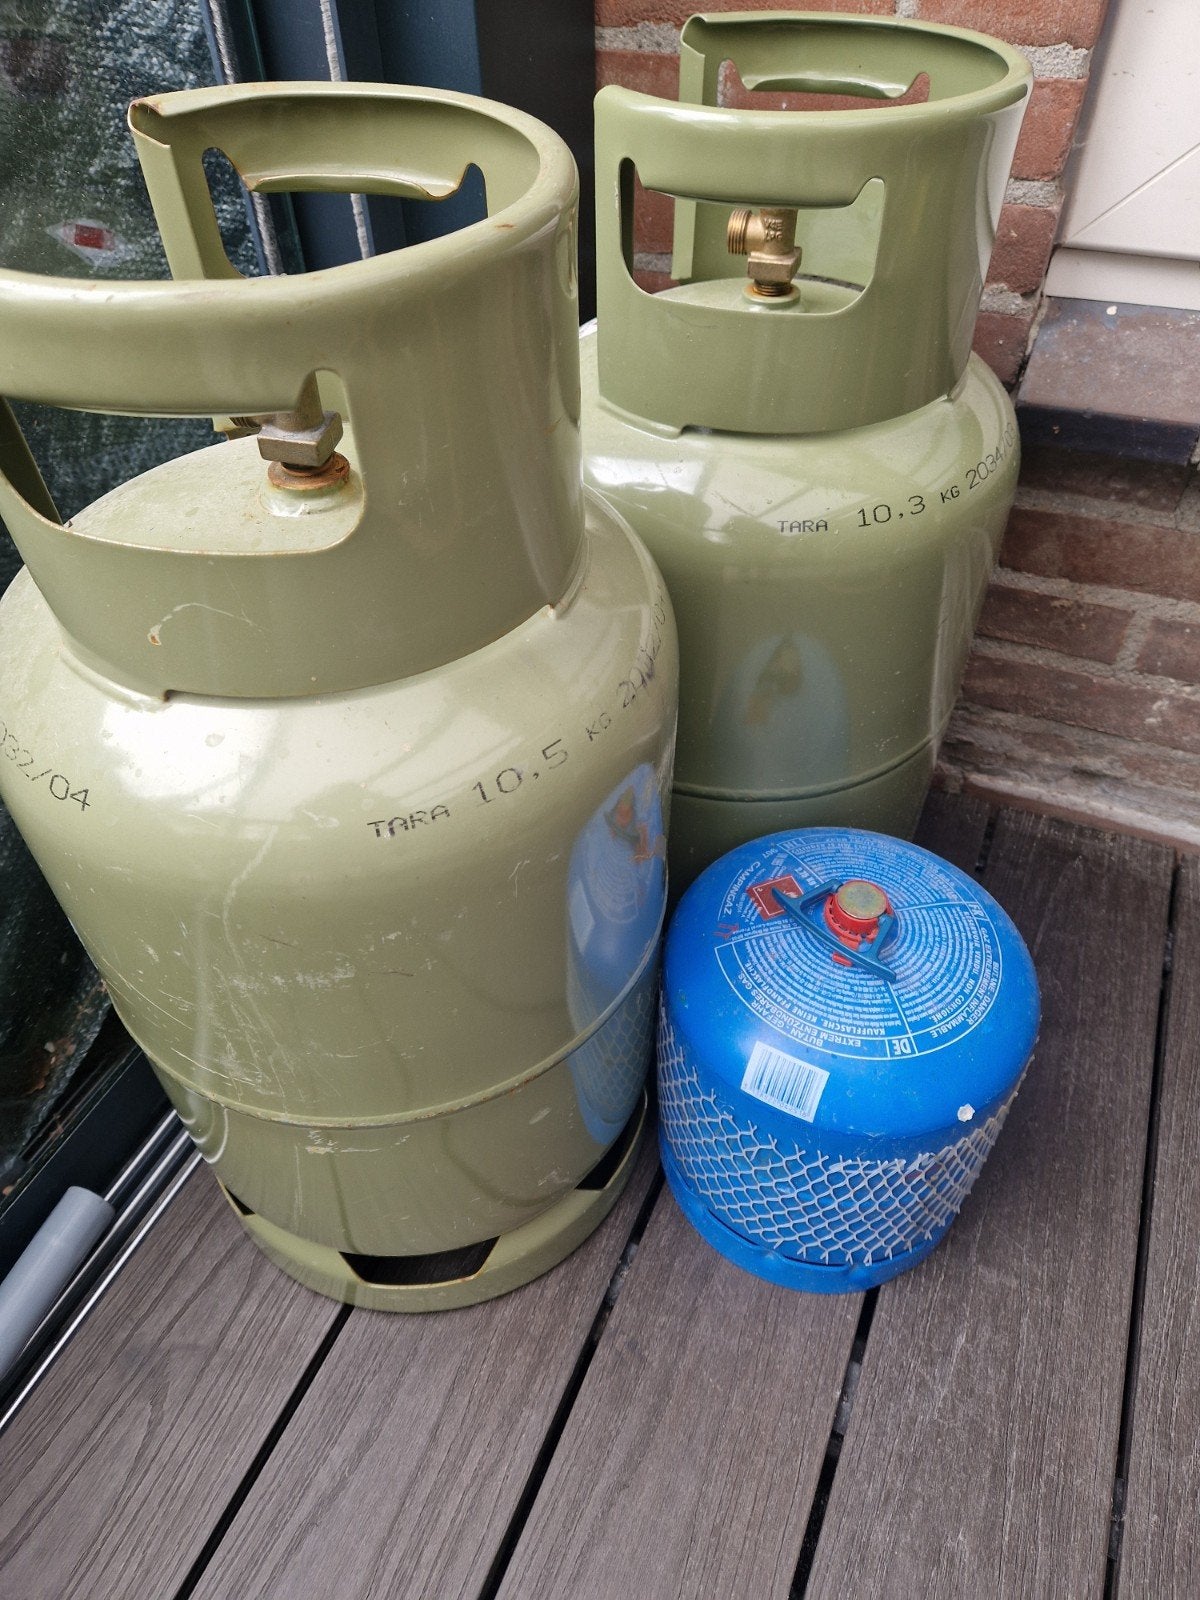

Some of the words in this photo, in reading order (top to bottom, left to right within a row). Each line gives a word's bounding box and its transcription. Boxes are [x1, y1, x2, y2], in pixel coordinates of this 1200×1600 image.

[777, 519, 829, 533] TARA
[857, 495, 925, 528] 10,3
[940, 485, 960, 504] KG
[366, 805, 451, 838] TARA
[471, 738, 569, 805] 10,5
[724, 861, 760, 915] CAMPINGAZ
[963, 978, 975, 993] NON
[988, 960, 999, 995] BUTANE
[750, 1000, 785, 1029] GEFAHR
[751, 987, 818, 1037] ENTZÜNDBARES
[792, 1006, 817, 1024] KEINE
[929, 998, 980, 1039] INFLAMMABLE
[966, 995, 991, 1026] DANGER
[790, 1027, 824, 1047] BUTAN
[820, 1018, 886, 1036] KAUFFLASCHE.
[820, 1031, 862, 1047] EXTREM
[891, 1038, 911, 1055] DE
